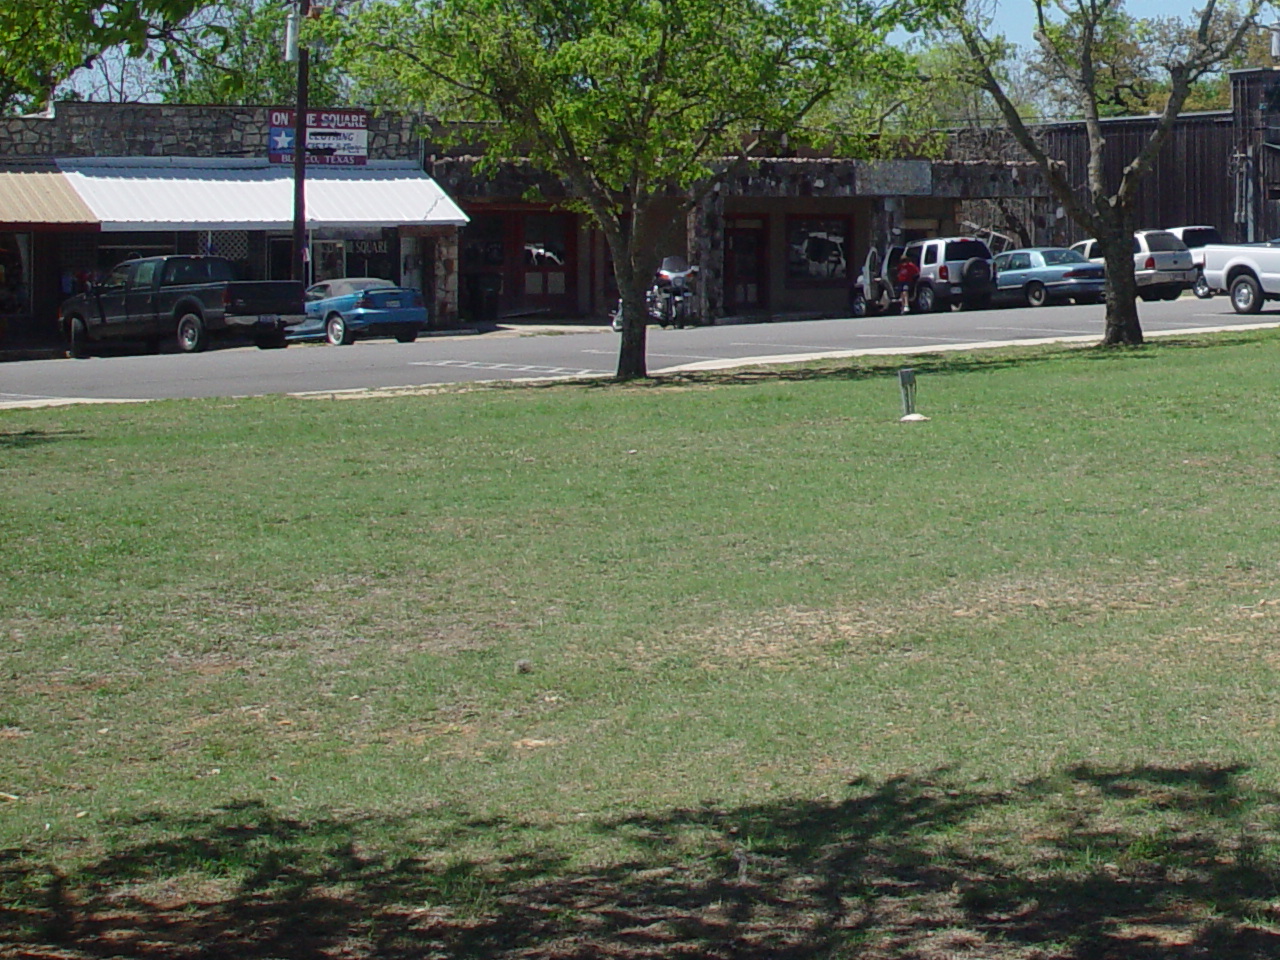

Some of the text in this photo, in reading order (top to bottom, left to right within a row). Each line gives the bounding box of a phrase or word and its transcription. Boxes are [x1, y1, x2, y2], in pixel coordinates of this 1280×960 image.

[272, 112, 289, 126] ON
[321, 113, 367, 129] SQUARE
[281, 154, 355, 164] BLCO, TEXAS
